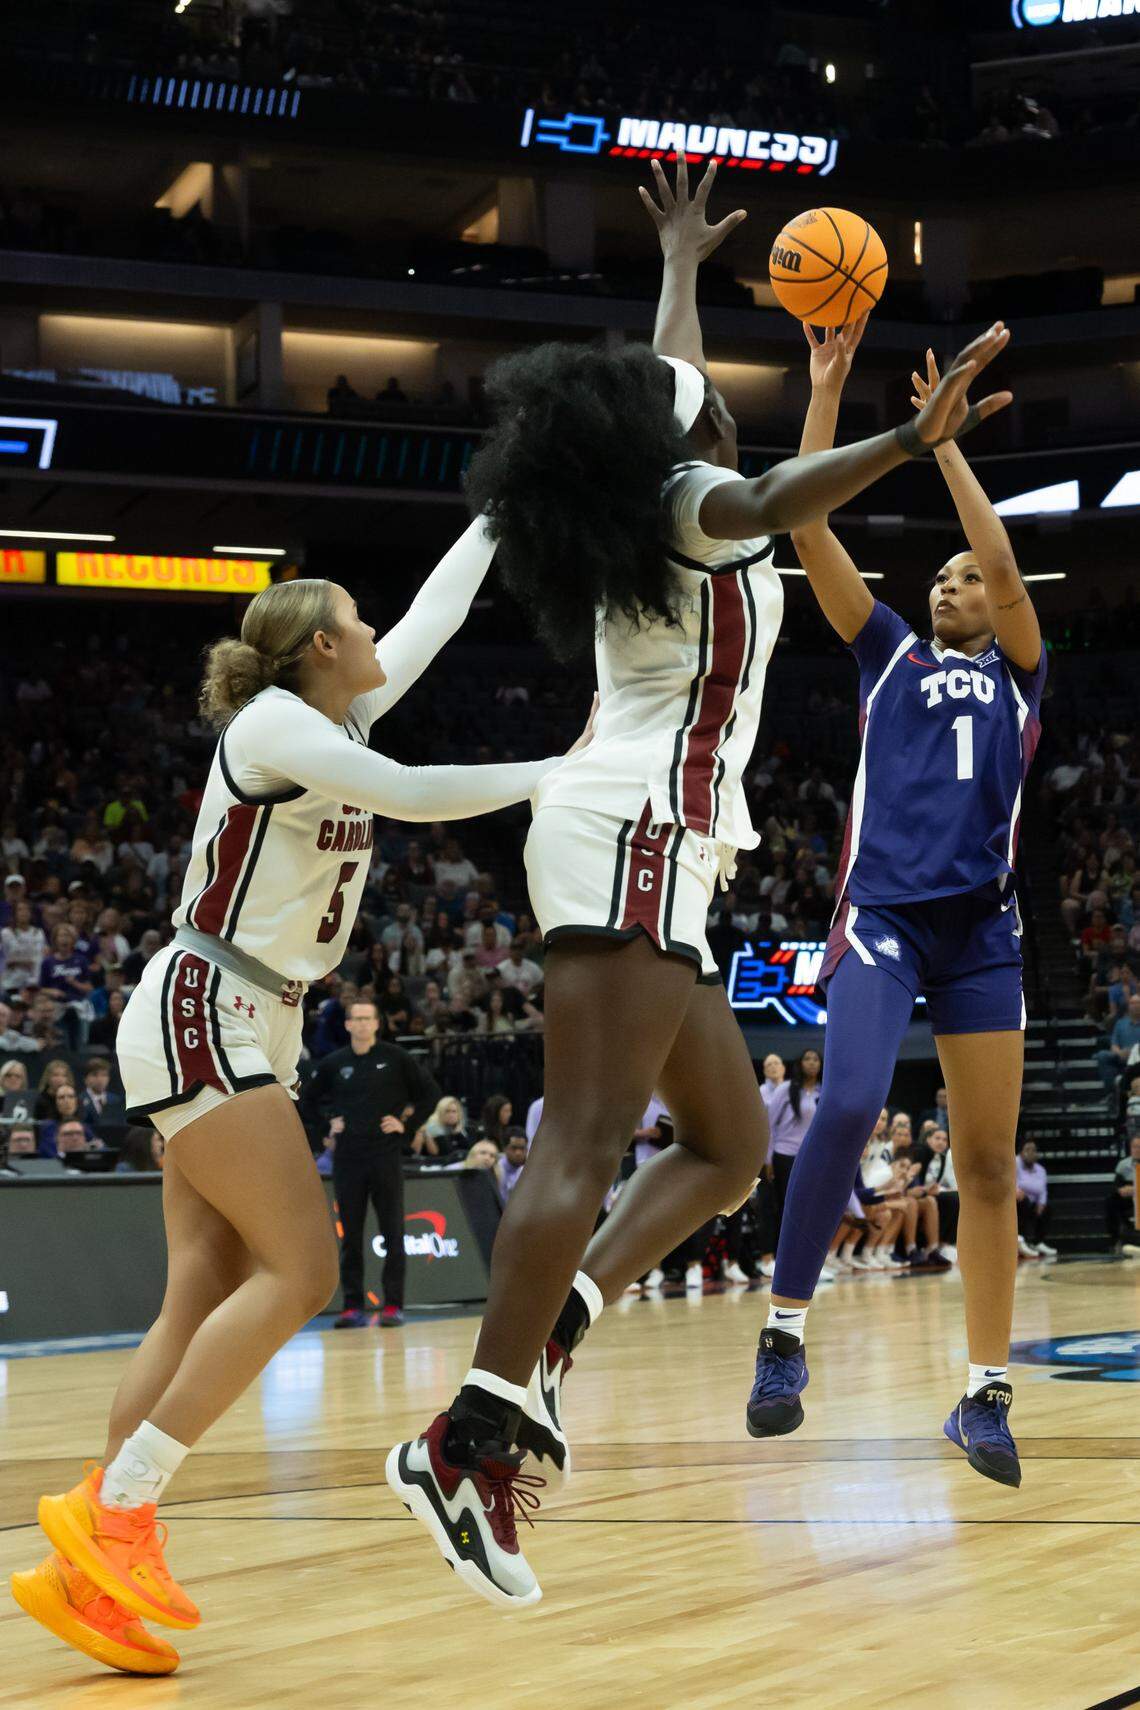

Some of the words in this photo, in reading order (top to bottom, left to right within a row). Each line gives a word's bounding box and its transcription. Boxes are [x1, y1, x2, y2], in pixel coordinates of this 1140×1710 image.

[617, 117, 828, 165] MADNESS
[920, 668, 995, 709] TCU
[951, 715, 974, 780] 1
[316, 861, 360, 944] 5
[986, 1389, 1011, 1405] TCU
